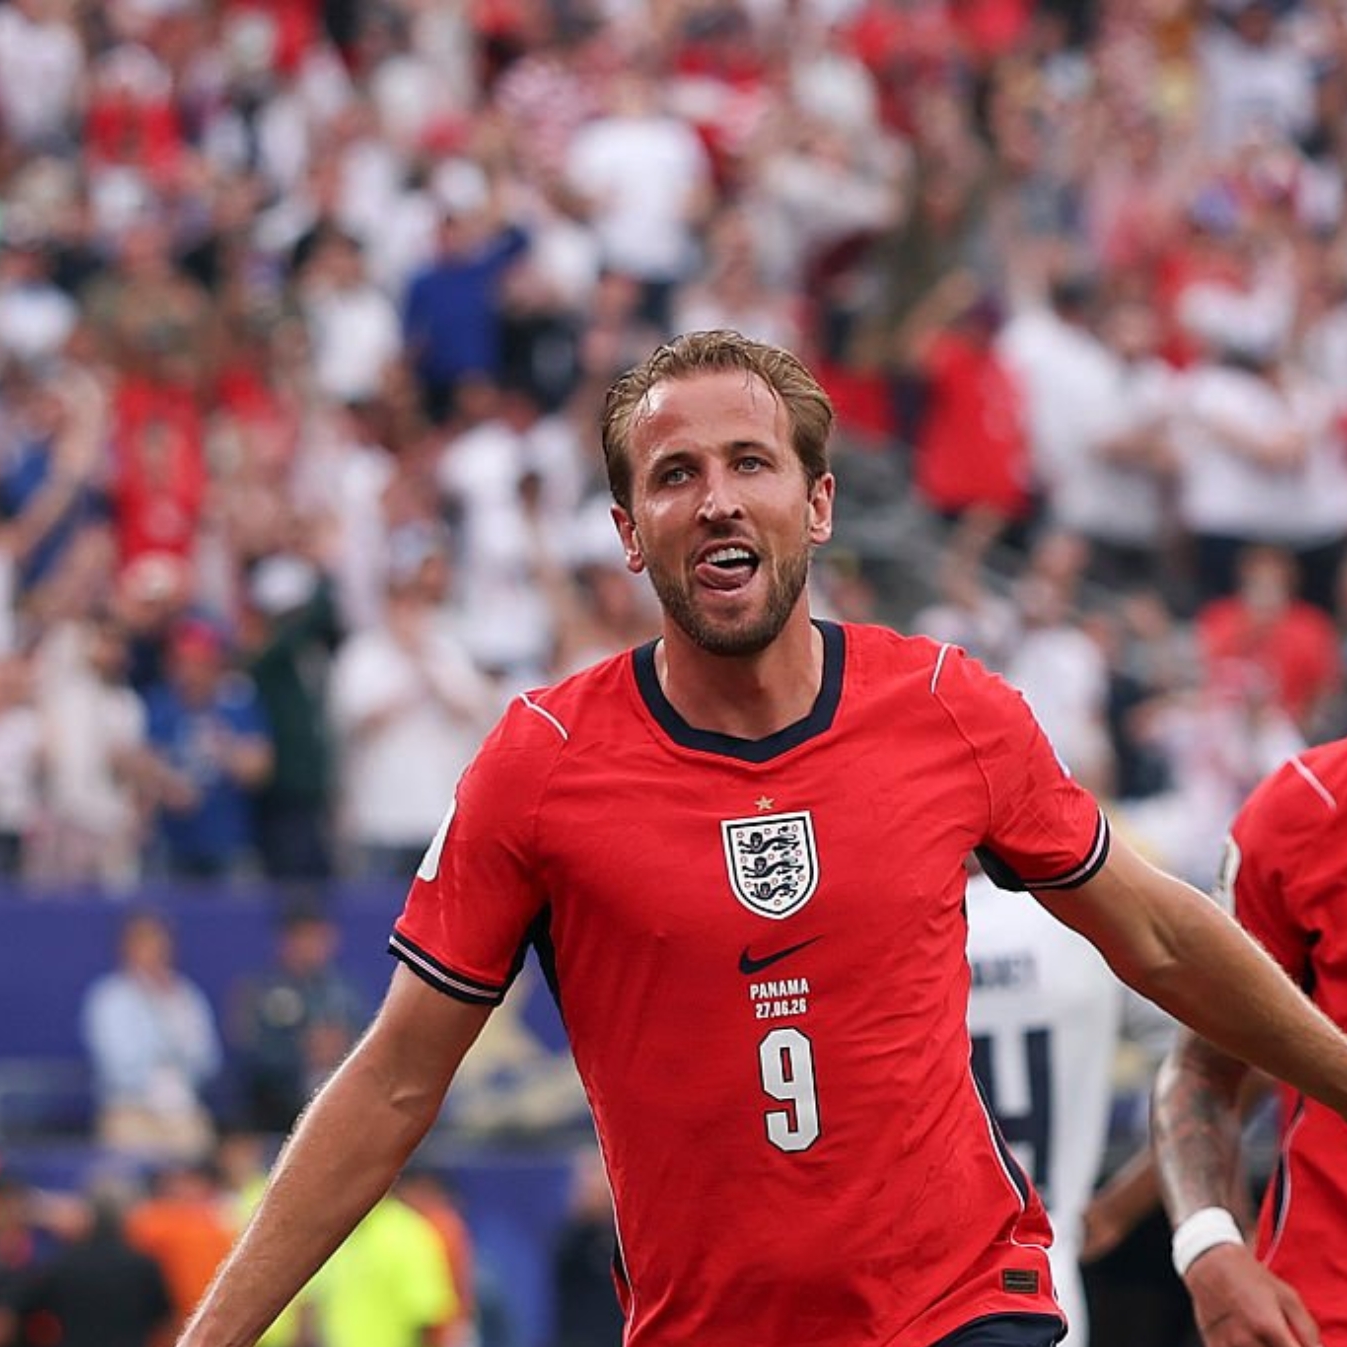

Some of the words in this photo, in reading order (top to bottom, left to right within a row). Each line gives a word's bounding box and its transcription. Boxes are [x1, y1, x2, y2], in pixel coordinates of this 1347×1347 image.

[749, 977, 810, 1001] PANAMA
[755, 997, 807, 1019] 27.06.26
[758, 1026, 822, 1153] 9
